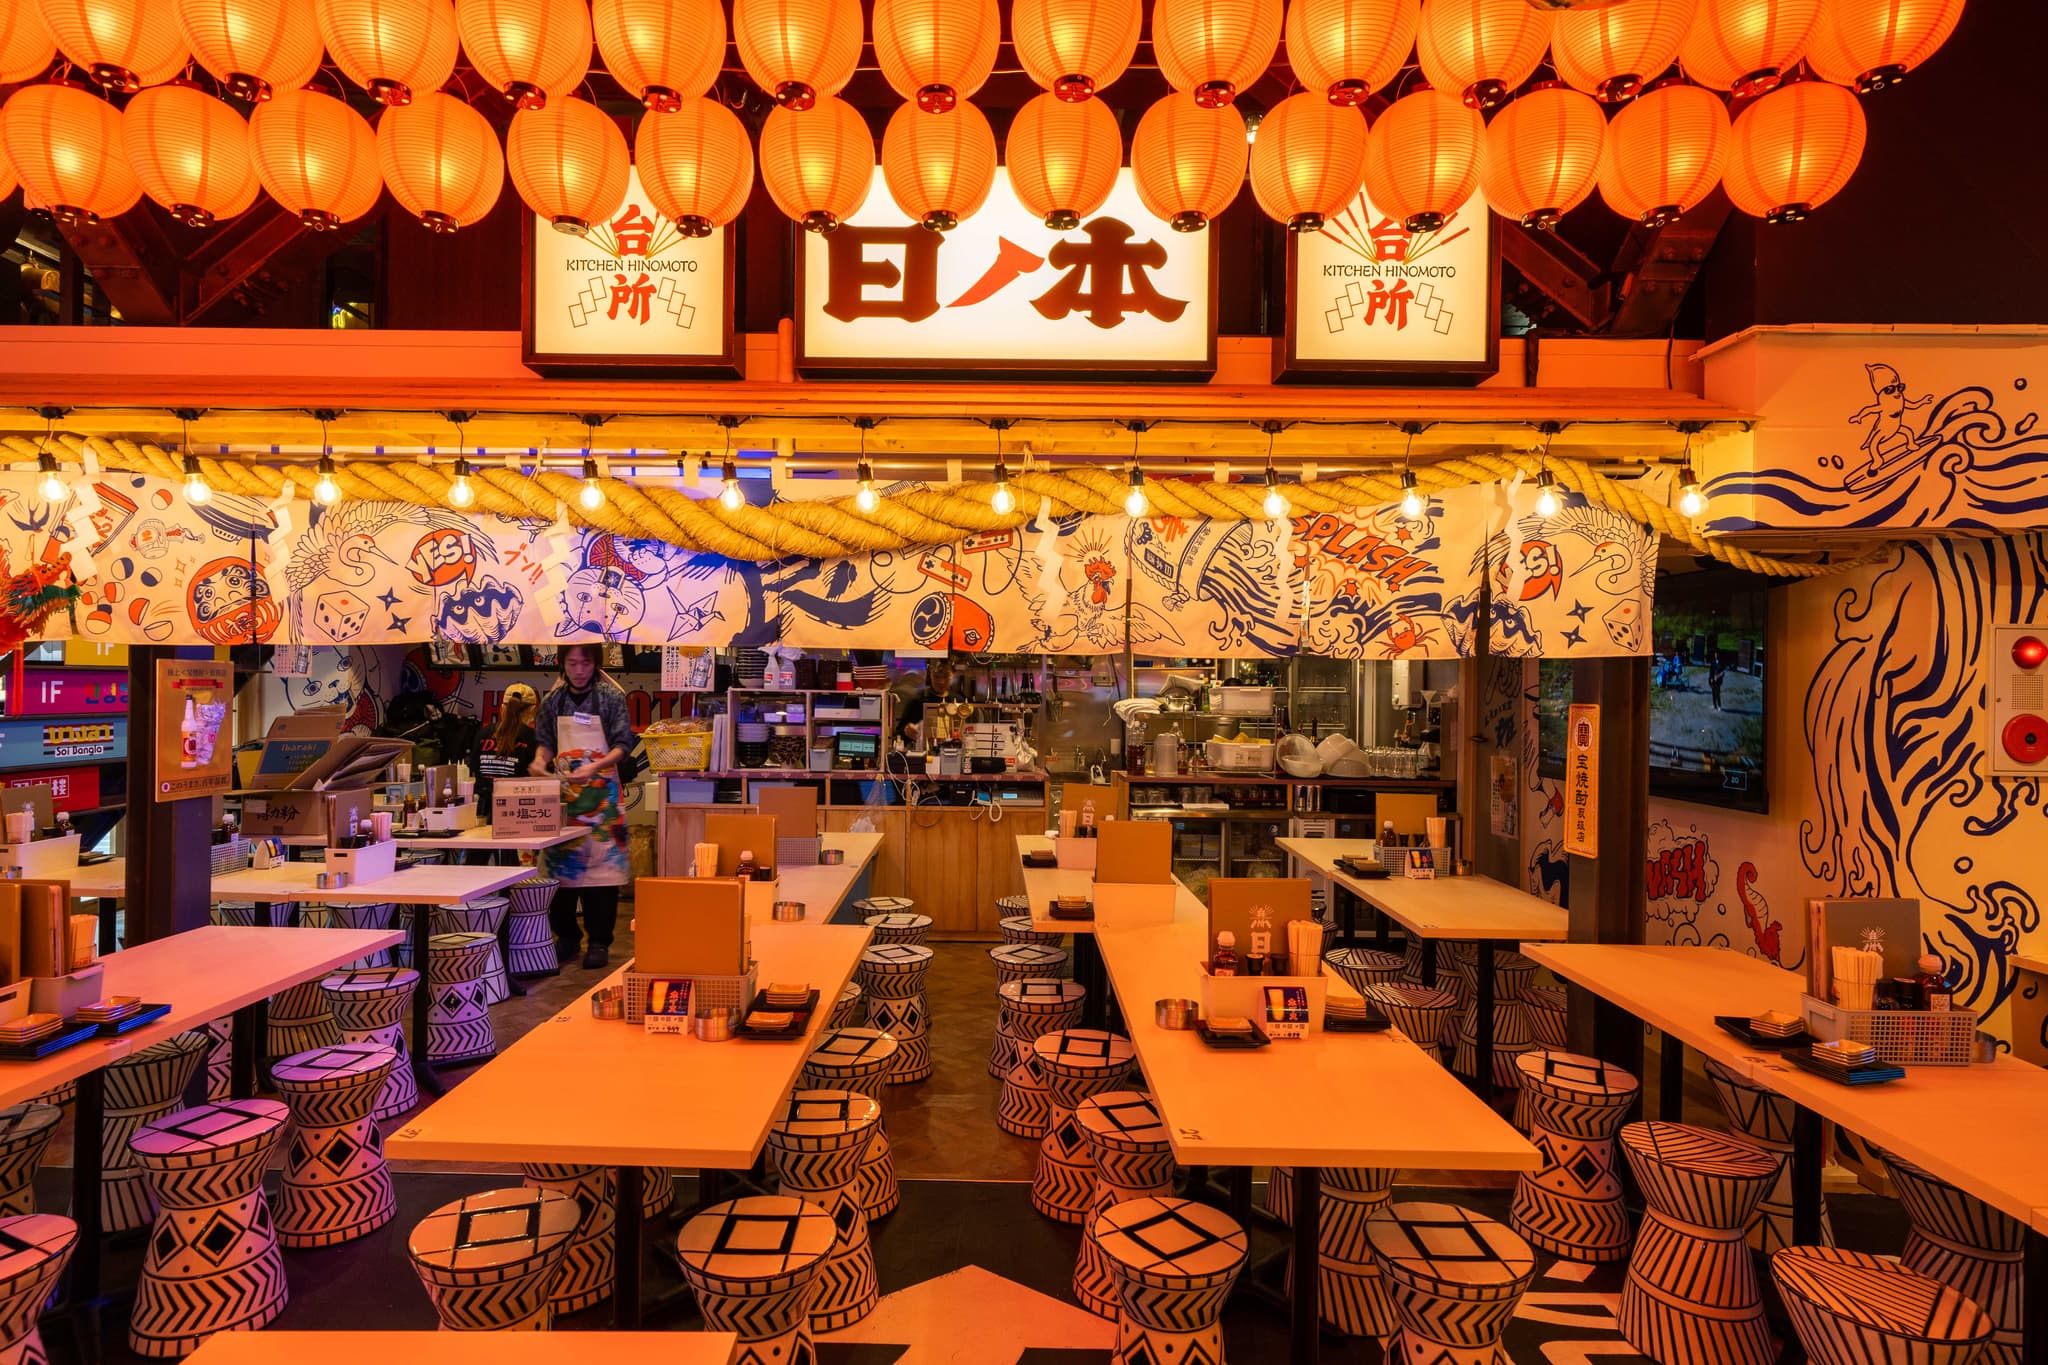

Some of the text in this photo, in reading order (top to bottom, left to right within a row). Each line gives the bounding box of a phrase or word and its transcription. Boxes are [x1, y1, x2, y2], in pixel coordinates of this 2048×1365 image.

[610, 204, 655, 257] 台
[566, 259, 698, 273] KITCHEN HINOMOTO
[1323, 265, 1456, 278] KITCHEN HINOMOTO
[607, 273, 657, 325] 所
[1364, 279, 1415, 331] 所
[405, 533, 475, 584] YES!
[56, 745, 103, 756] Soi Bangla
